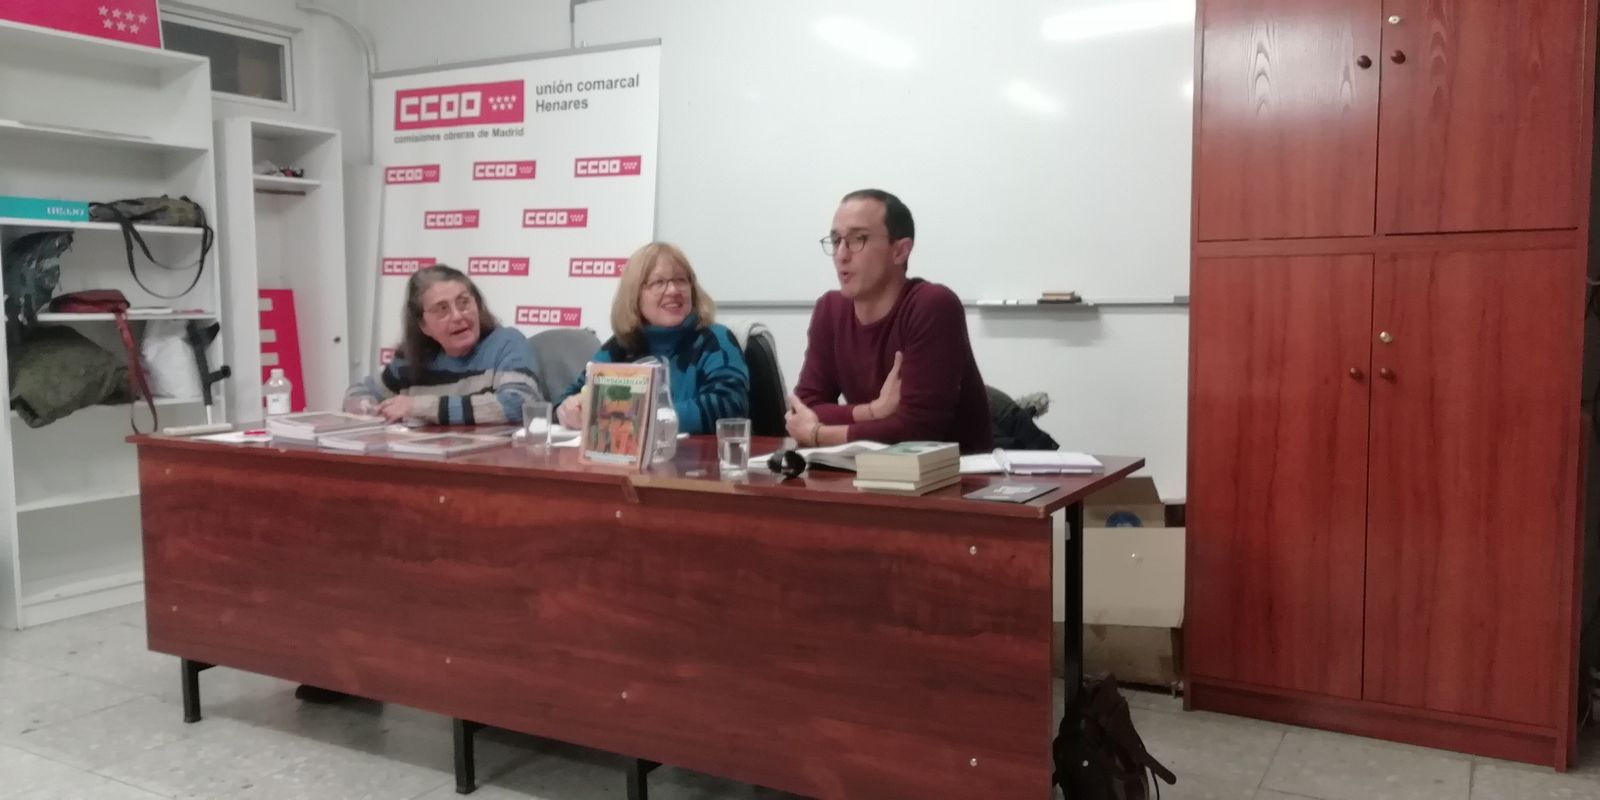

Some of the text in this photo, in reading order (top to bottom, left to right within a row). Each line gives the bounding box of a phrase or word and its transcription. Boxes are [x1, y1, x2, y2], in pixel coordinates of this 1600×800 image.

[535, 74, 640, 95] unión comarcal
[400, 91, 482, 122] CCOO
[535, 98, 589, 113] Henares
[394, 127, 524, 143] comisiones obreras de Madrid
[386, 168, 423, 182] CCOO
[474, 164, 517, 178] CCOO
[576, 160, 621, 175] CCOO
[426, 212, 462, 227] CCOO
[525, 211, 567, 226] CCOO
[384, 260, 419, 273] CCOO
[469, 259, 509, 273] CCOO
[571, 260, 615, 275] CCOO
[517, 308, 561, 323] CCOO
